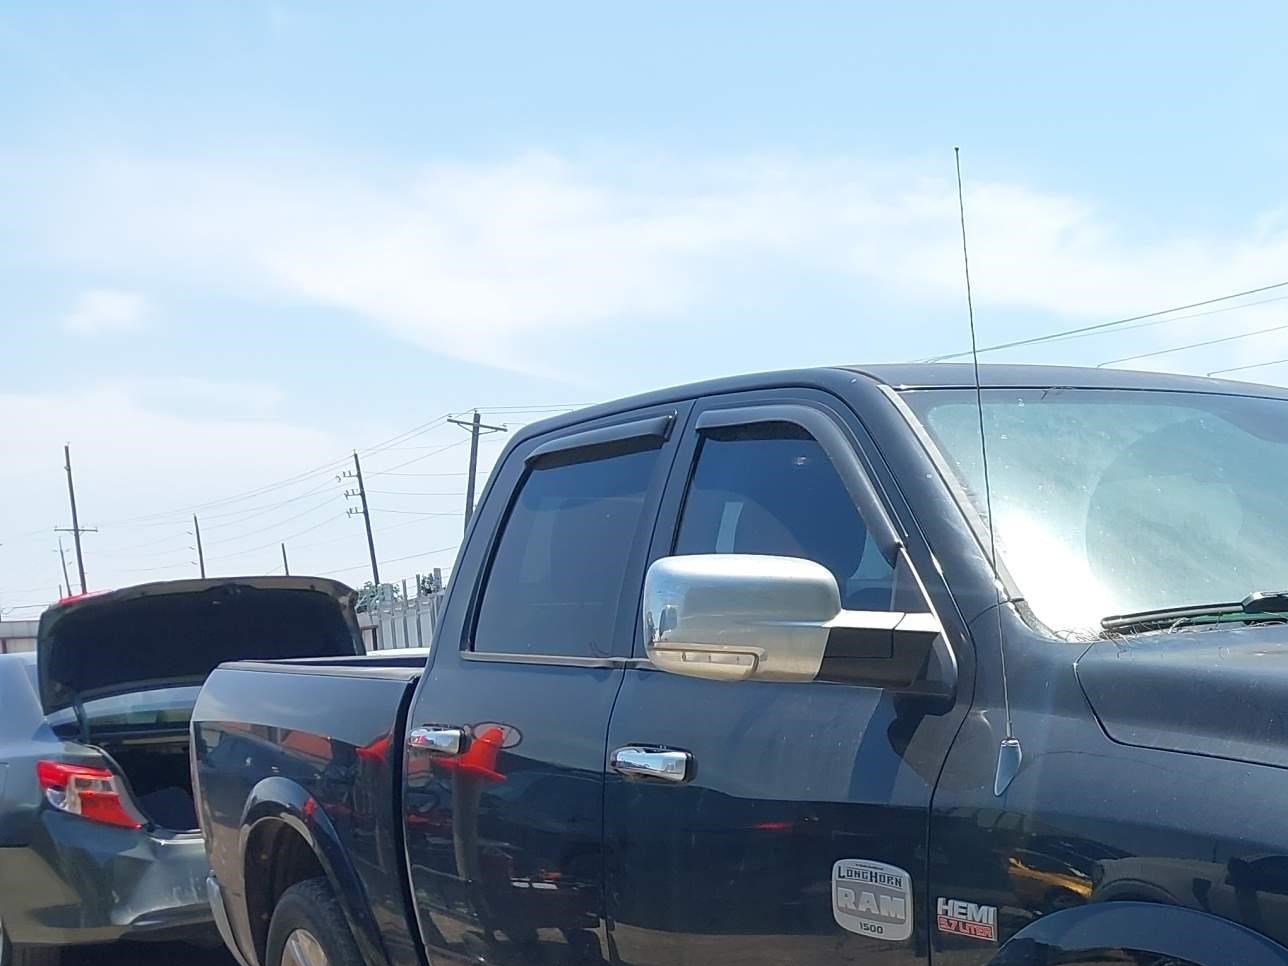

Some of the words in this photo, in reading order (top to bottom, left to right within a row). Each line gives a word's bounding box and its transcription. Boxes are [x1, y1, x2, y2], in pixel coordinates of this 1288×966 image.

[837, 887, 905, 919] RAM
[937, 898, 995, 925] HEMI
[859, 922, 884, 935] 1500
[960, 920, 993, 938] LITER
